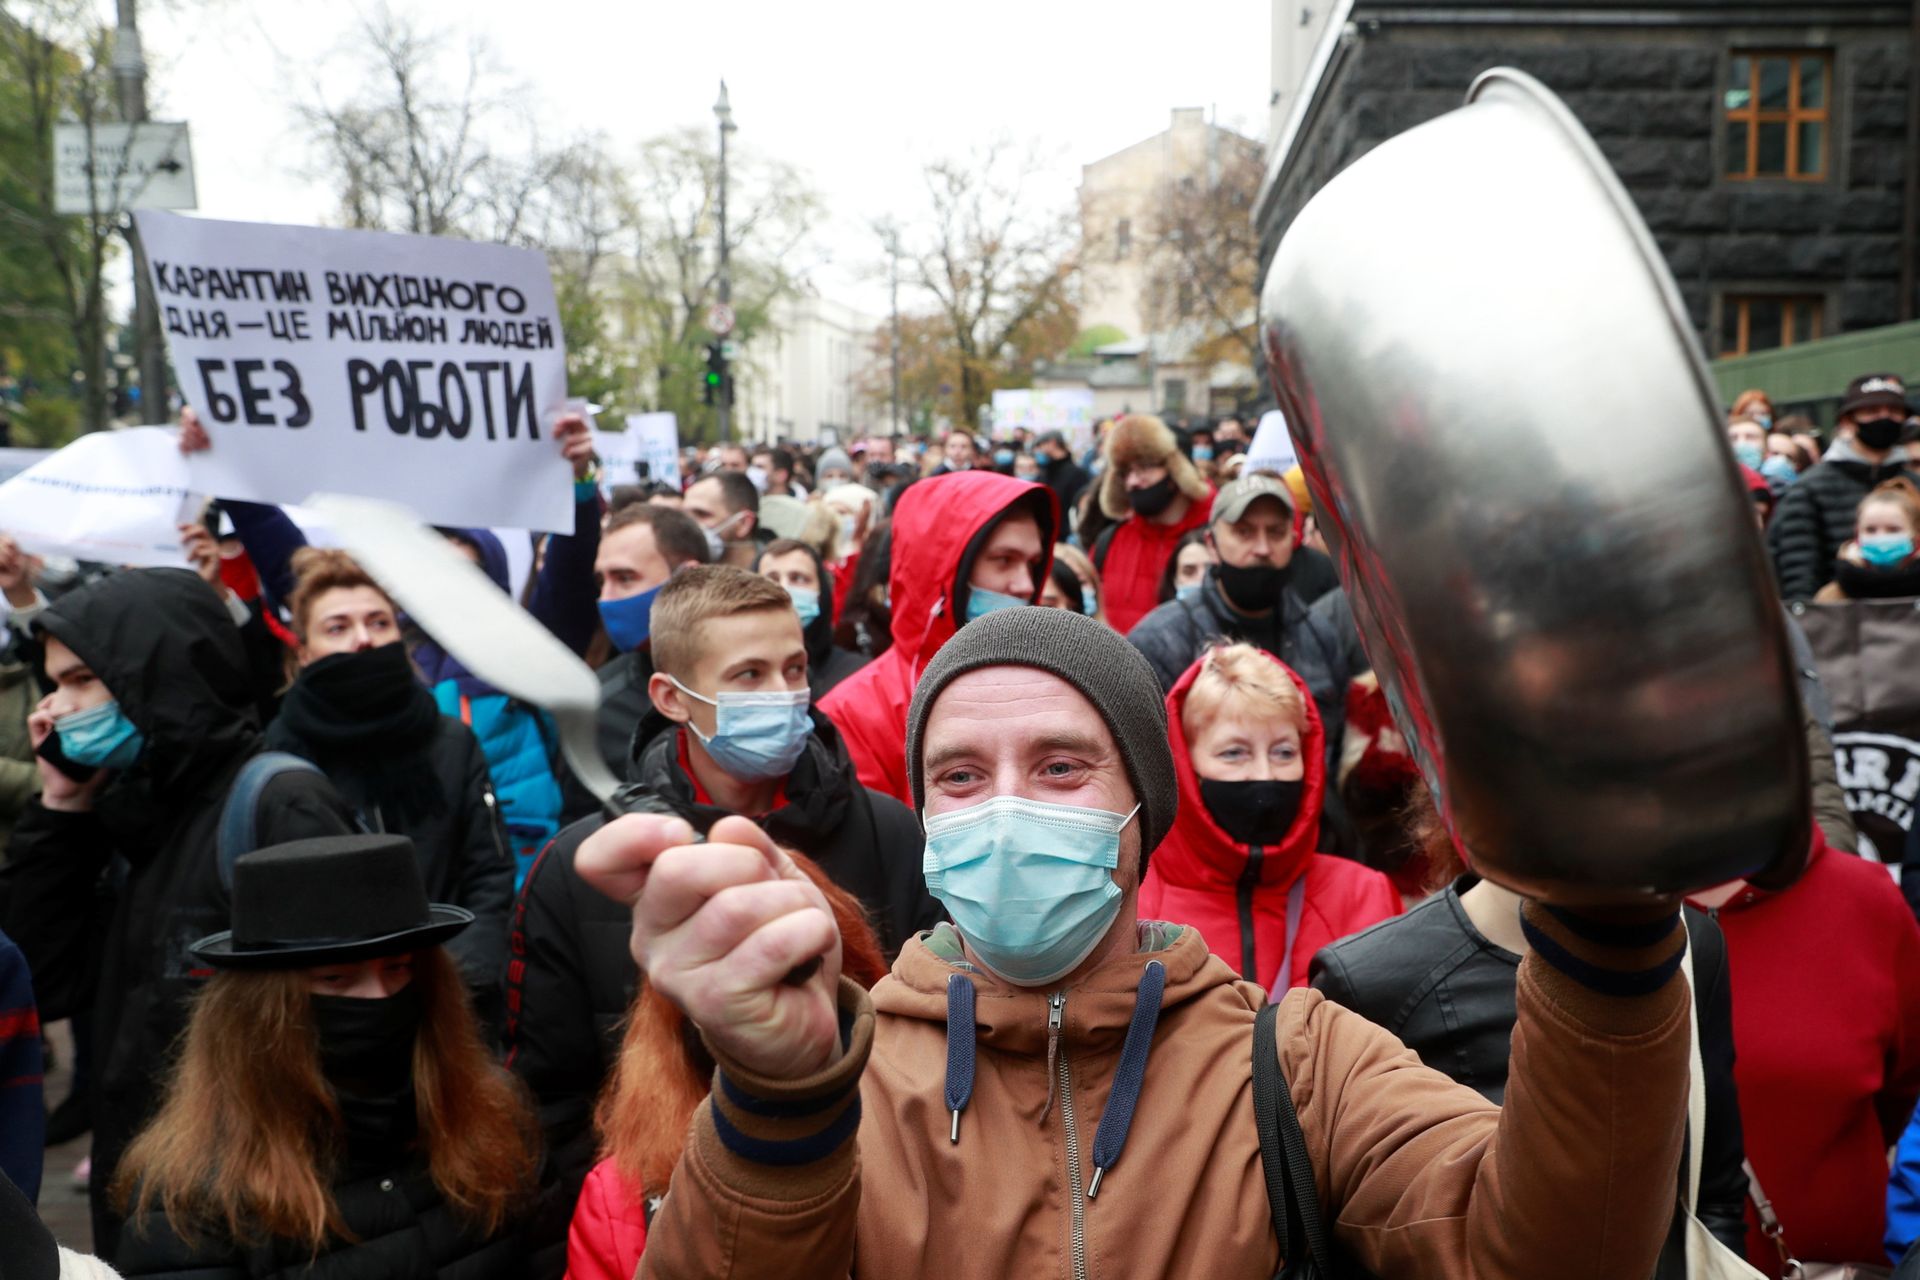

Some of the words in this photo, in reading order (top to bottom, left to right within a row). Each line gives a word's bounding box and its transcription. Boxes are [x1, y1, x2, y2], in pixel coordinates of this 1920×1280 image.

[154, 261, 311, 303] КАРАНТИН
[325, 271, 527, 315] ВИХІДНОГО
[328, 309, 448, 343] МІЛЬЙОН
[459, 316, 553, 349] ЛЮДЕЙ
[197, 358, 312, 429] БЕЗ
[346, 358, 541, 440] РОБОТИ
